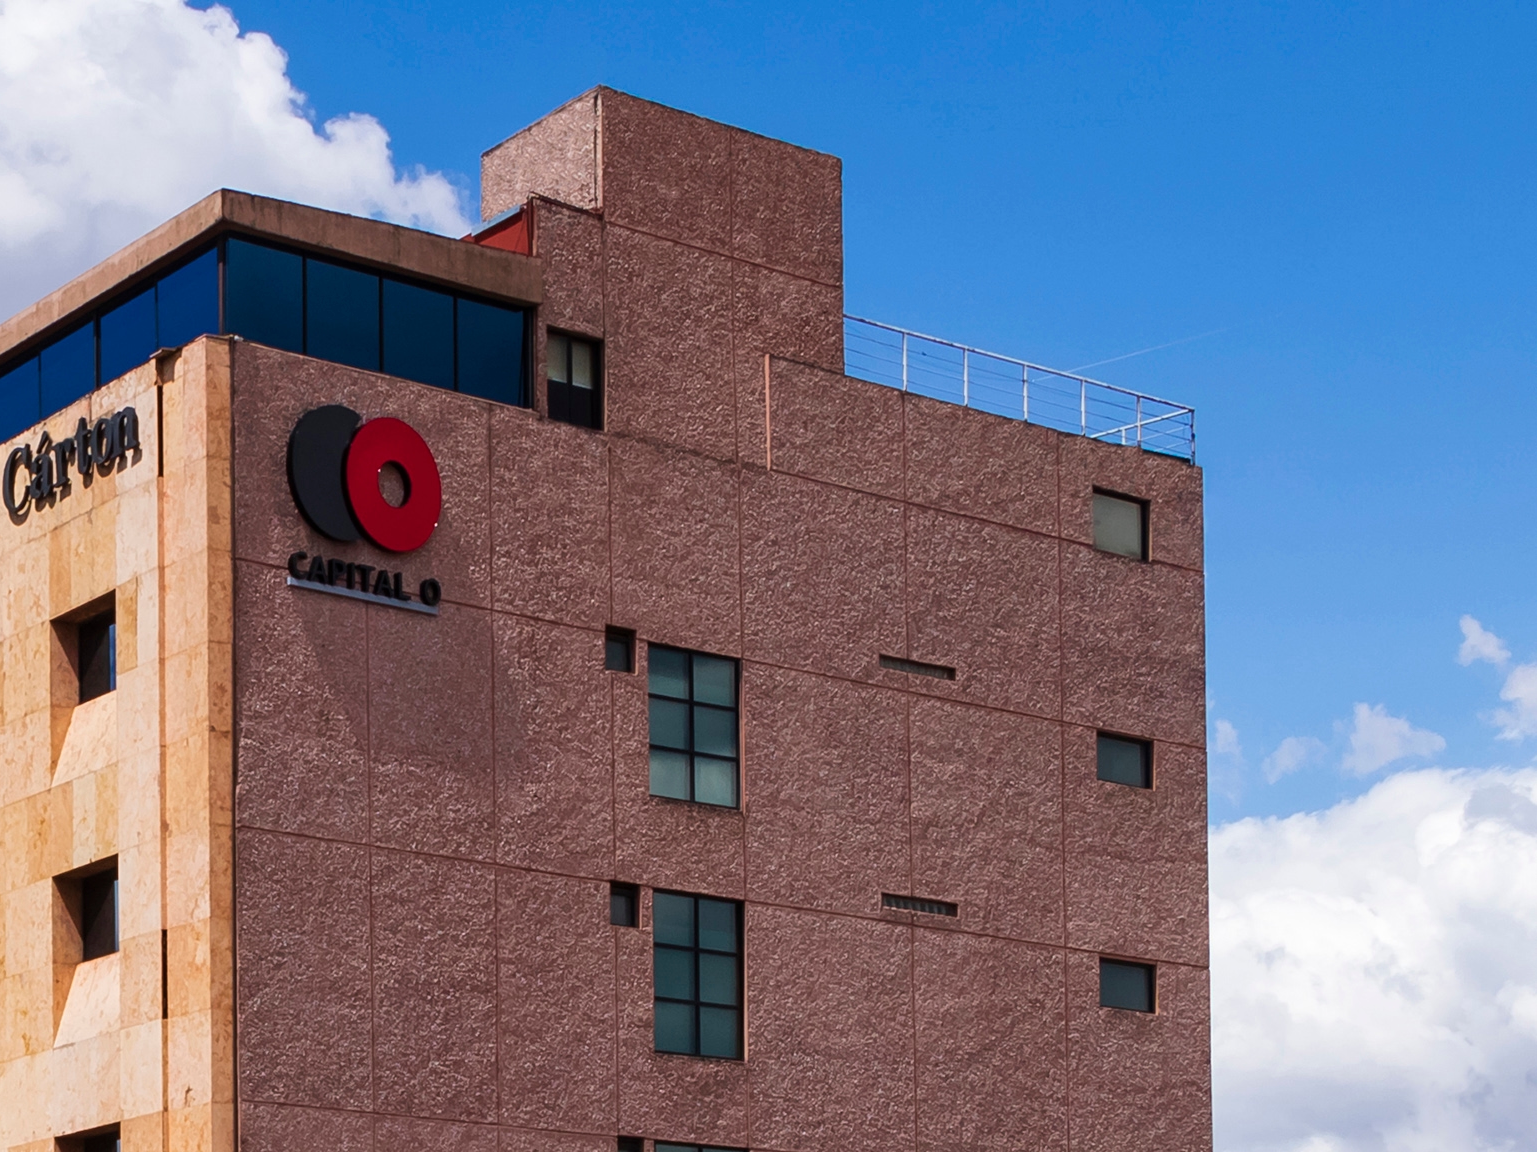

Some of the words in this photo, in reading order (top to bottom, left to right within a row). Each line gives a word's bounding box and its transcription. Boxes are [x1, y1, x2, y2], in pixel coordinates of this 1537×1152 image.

[2, 406, 140, 514] Cárton
[287, 551, 412, 601] CAPITAL
[419, 577, 442, 606] O
